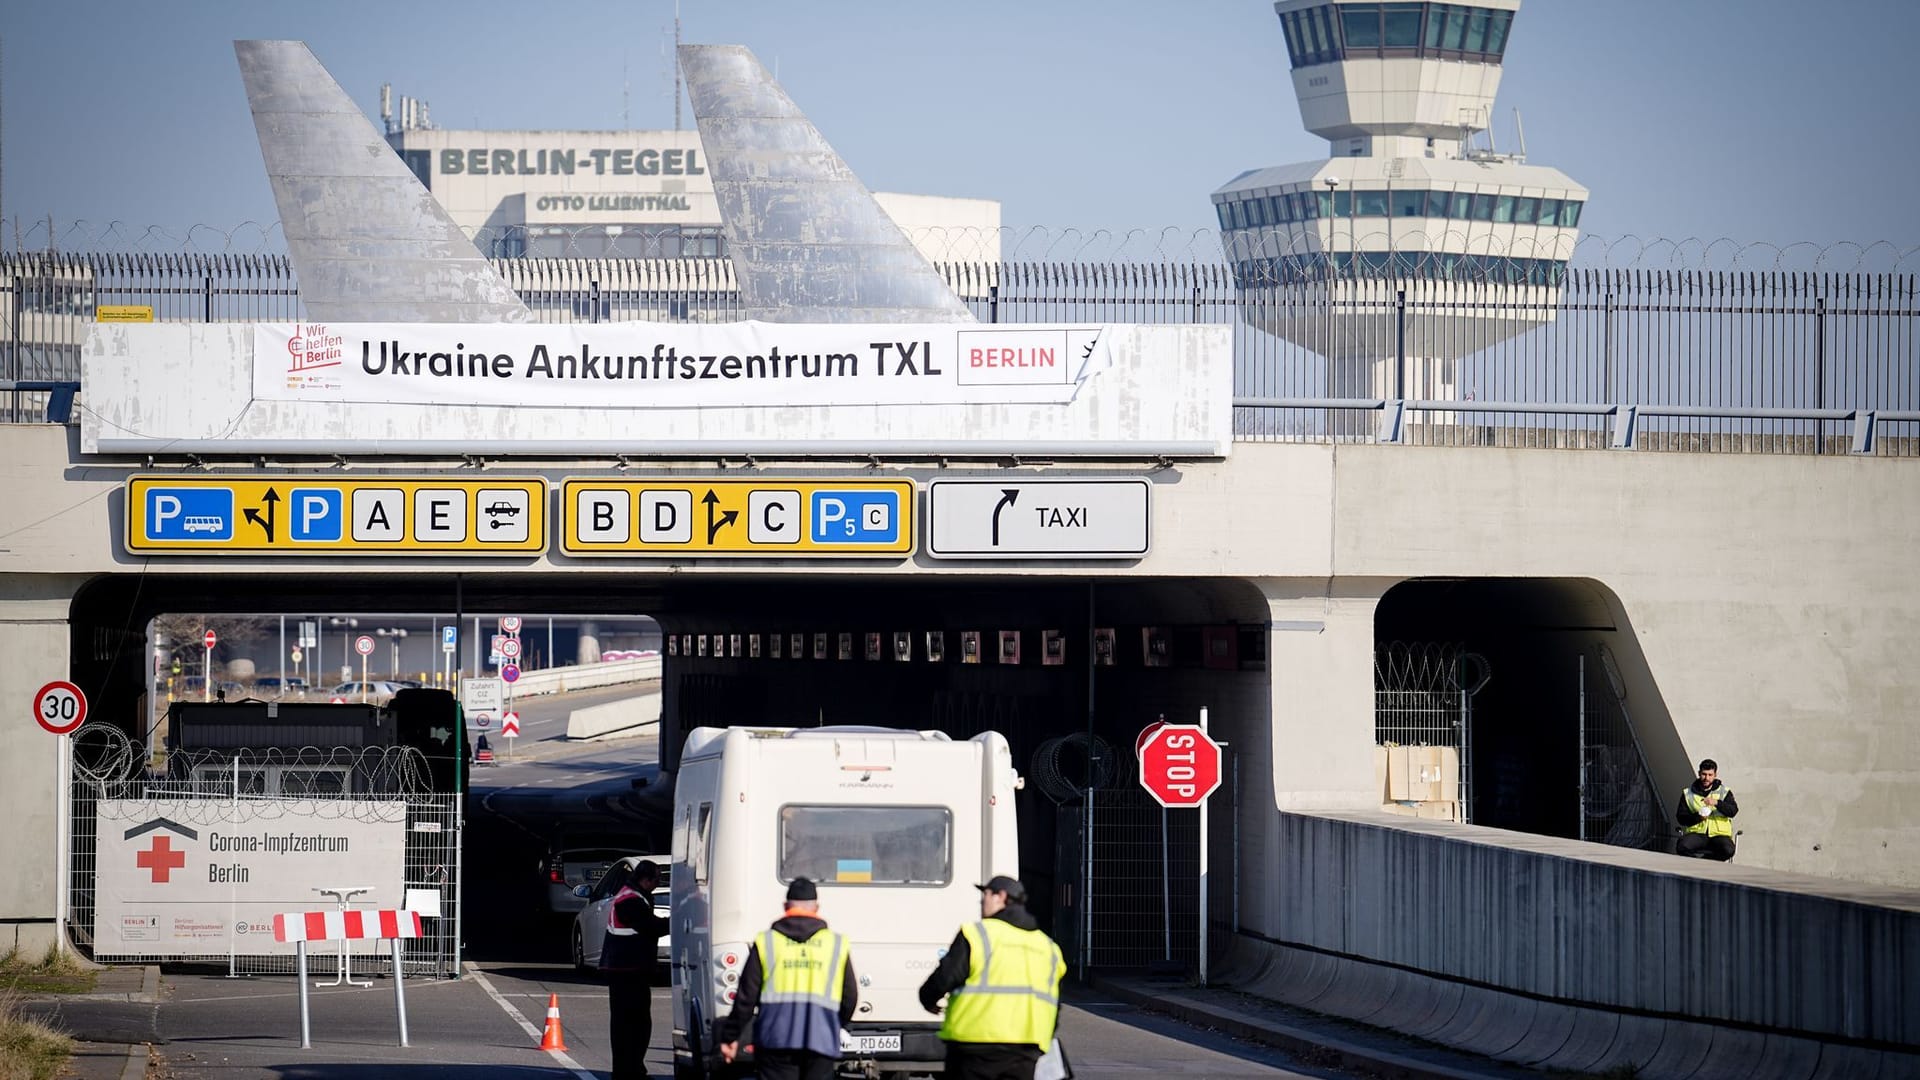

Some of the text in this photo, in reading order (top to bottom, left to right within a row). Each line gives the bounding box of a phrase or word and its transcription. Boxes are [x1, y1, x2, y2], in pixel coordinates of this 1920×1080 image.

[440, 149, 704, 175] BERLIN-TEGEL
[536, 195, 691, 211] OTTO LILIENTHAL
[306, 324, 326, 337] Wir
[306, 335, 342, 350] helfen
[306, 347, 341, 363] Berlin
[362, 340, 942, 380] Ukraine Ankunftszentrum TXL
[970, 348, 1055, 367] BERLIN
[155, 495, 450, 534] P P A E
[593, 501, 614, 531] B
[655, 501, 677, 532] D
[764, 502, 785, 532] C
[870, 510, 881, 525] C
[1036, 507, 1087, 527] TAXI
[359, 641, 371, 650] 30
[505, 644, 517, 653] 30
[45, 695, 75, 720] 30
[1166, 735, 1195, 798] STOP
[210, 832, 348, 855] Corona-Impfzentrum
[209, 863, 249, 882] Berlin
[860, 1037, 875, 1048] RD
[877, 1037, 899, 1049] 666
